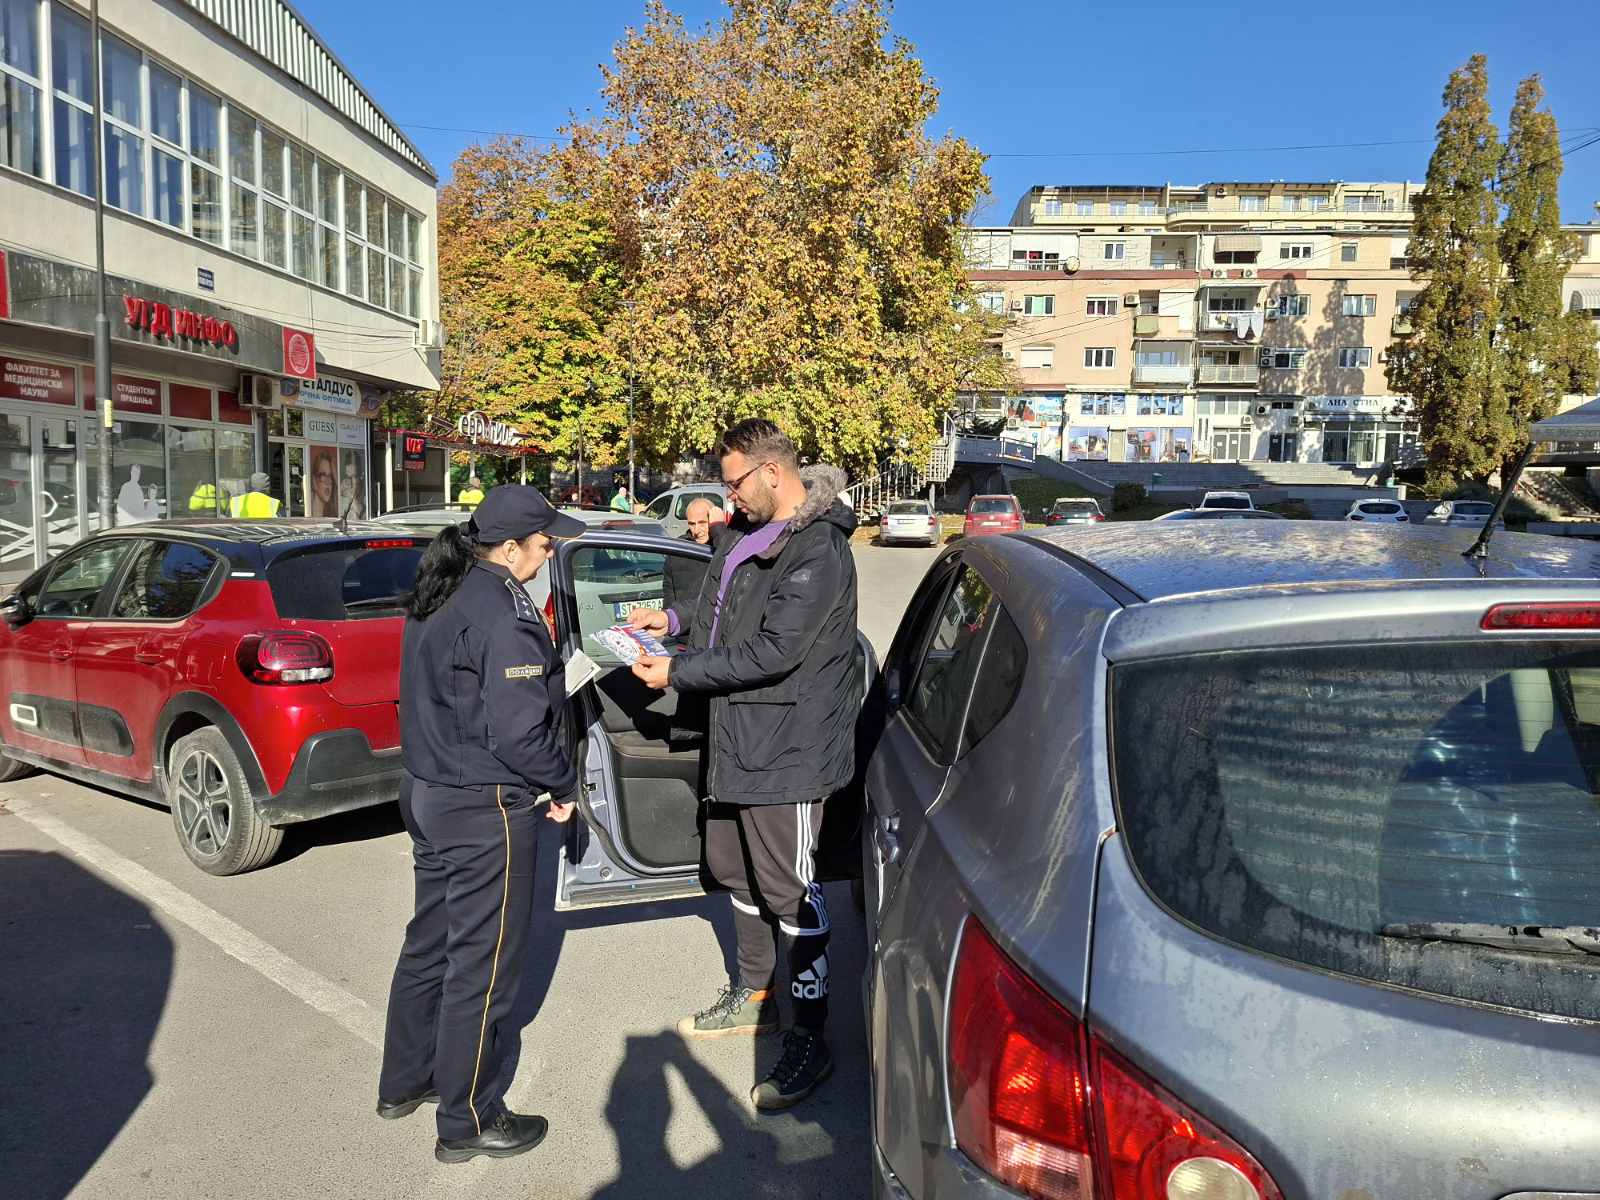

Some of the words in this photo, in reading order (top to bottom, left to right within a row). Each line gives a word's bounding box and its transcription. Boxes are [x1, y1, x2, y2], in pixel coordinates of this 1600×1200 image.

[175, 308, 237, 347] ИНФО
[6, 362, 49, 377] ФАКУЛТЕТ
[49, 368, 61, 378] ЗА
[4, 373, 63, 389] МЕДИЦИНСКИ
[20, 387, 49, 398] НАУКИ
[116, 383, 156, 395] СТУДЕНТСКИ
[308, 419, 335, 433] GUESS
